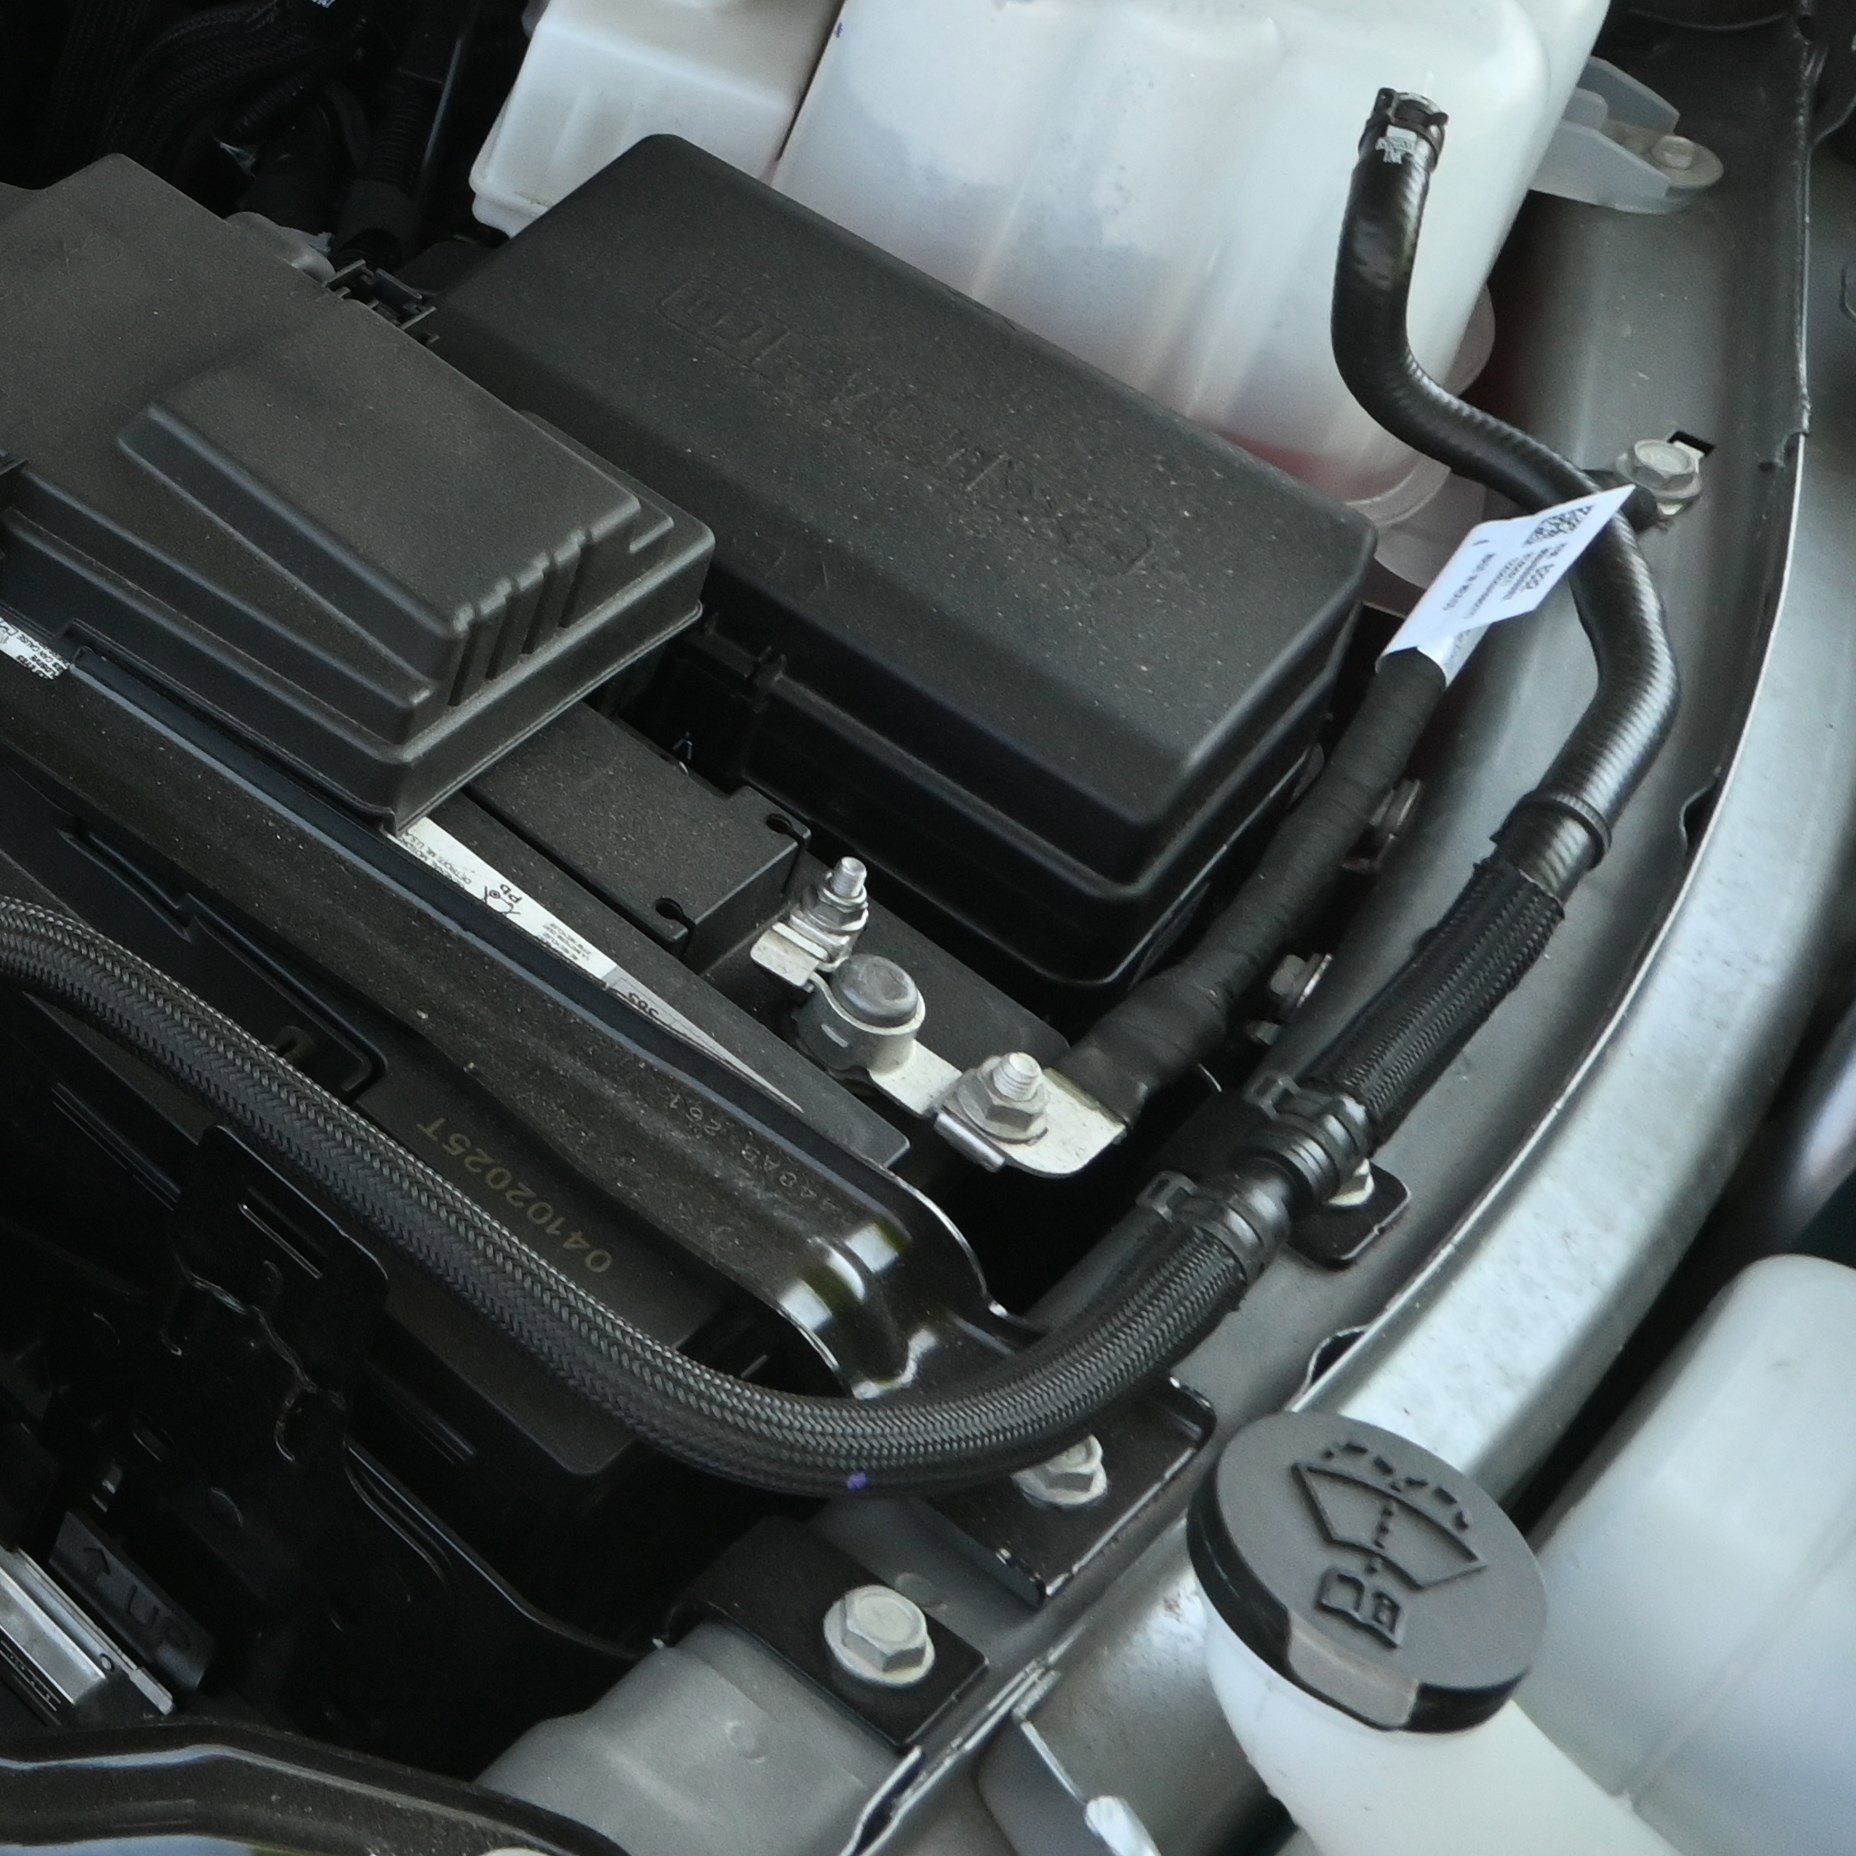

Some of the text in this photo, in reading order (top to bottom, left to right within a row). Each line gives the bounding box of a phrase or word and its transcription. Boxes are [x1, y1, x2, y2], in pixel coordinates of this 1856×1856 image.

[16, 633, 40, 653] CAUSE
[37, 649, 54, 664] CAN
[497, 883, 523, 904] Pb
[417, 1117, 612, 1275] 04102025T
